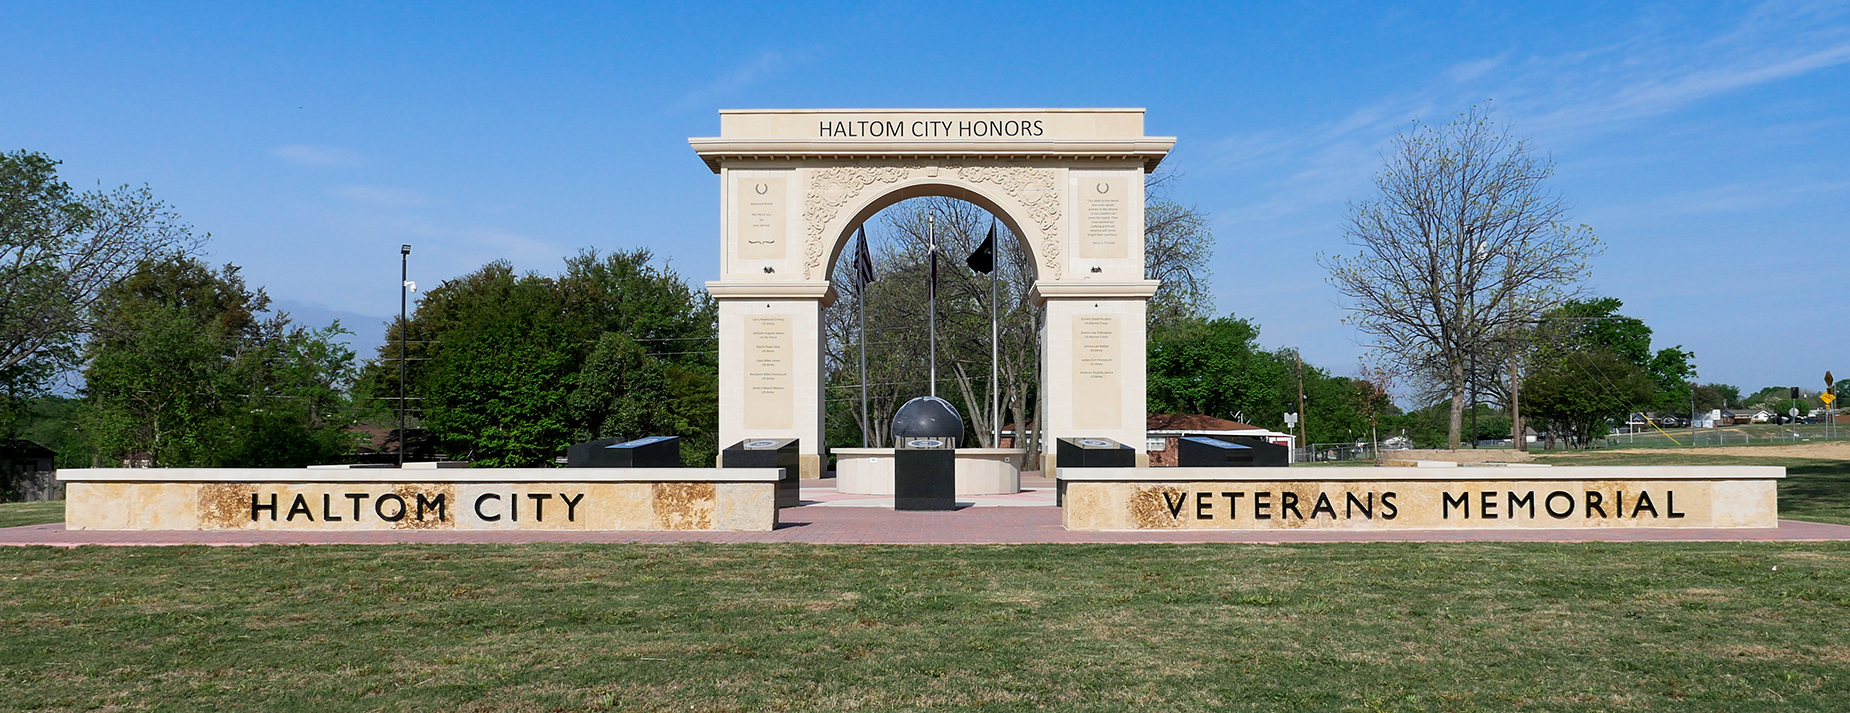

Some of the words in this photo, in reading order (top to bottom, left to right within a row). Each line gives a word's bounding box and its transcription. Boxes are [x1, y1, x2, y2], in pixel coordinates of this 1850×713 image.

[819, 120, 904, 138] HALTOM
[911, 120, 953, 138] CITY
[959, 120, 1044, 138] HONORS
[250, 493, 448, 523] HALTOM
[473, 493, 585, 523] CITY
[1162, 490, 1399, 521] VETERANS
[1442, 490, 1686, 521] MEMORIAL
